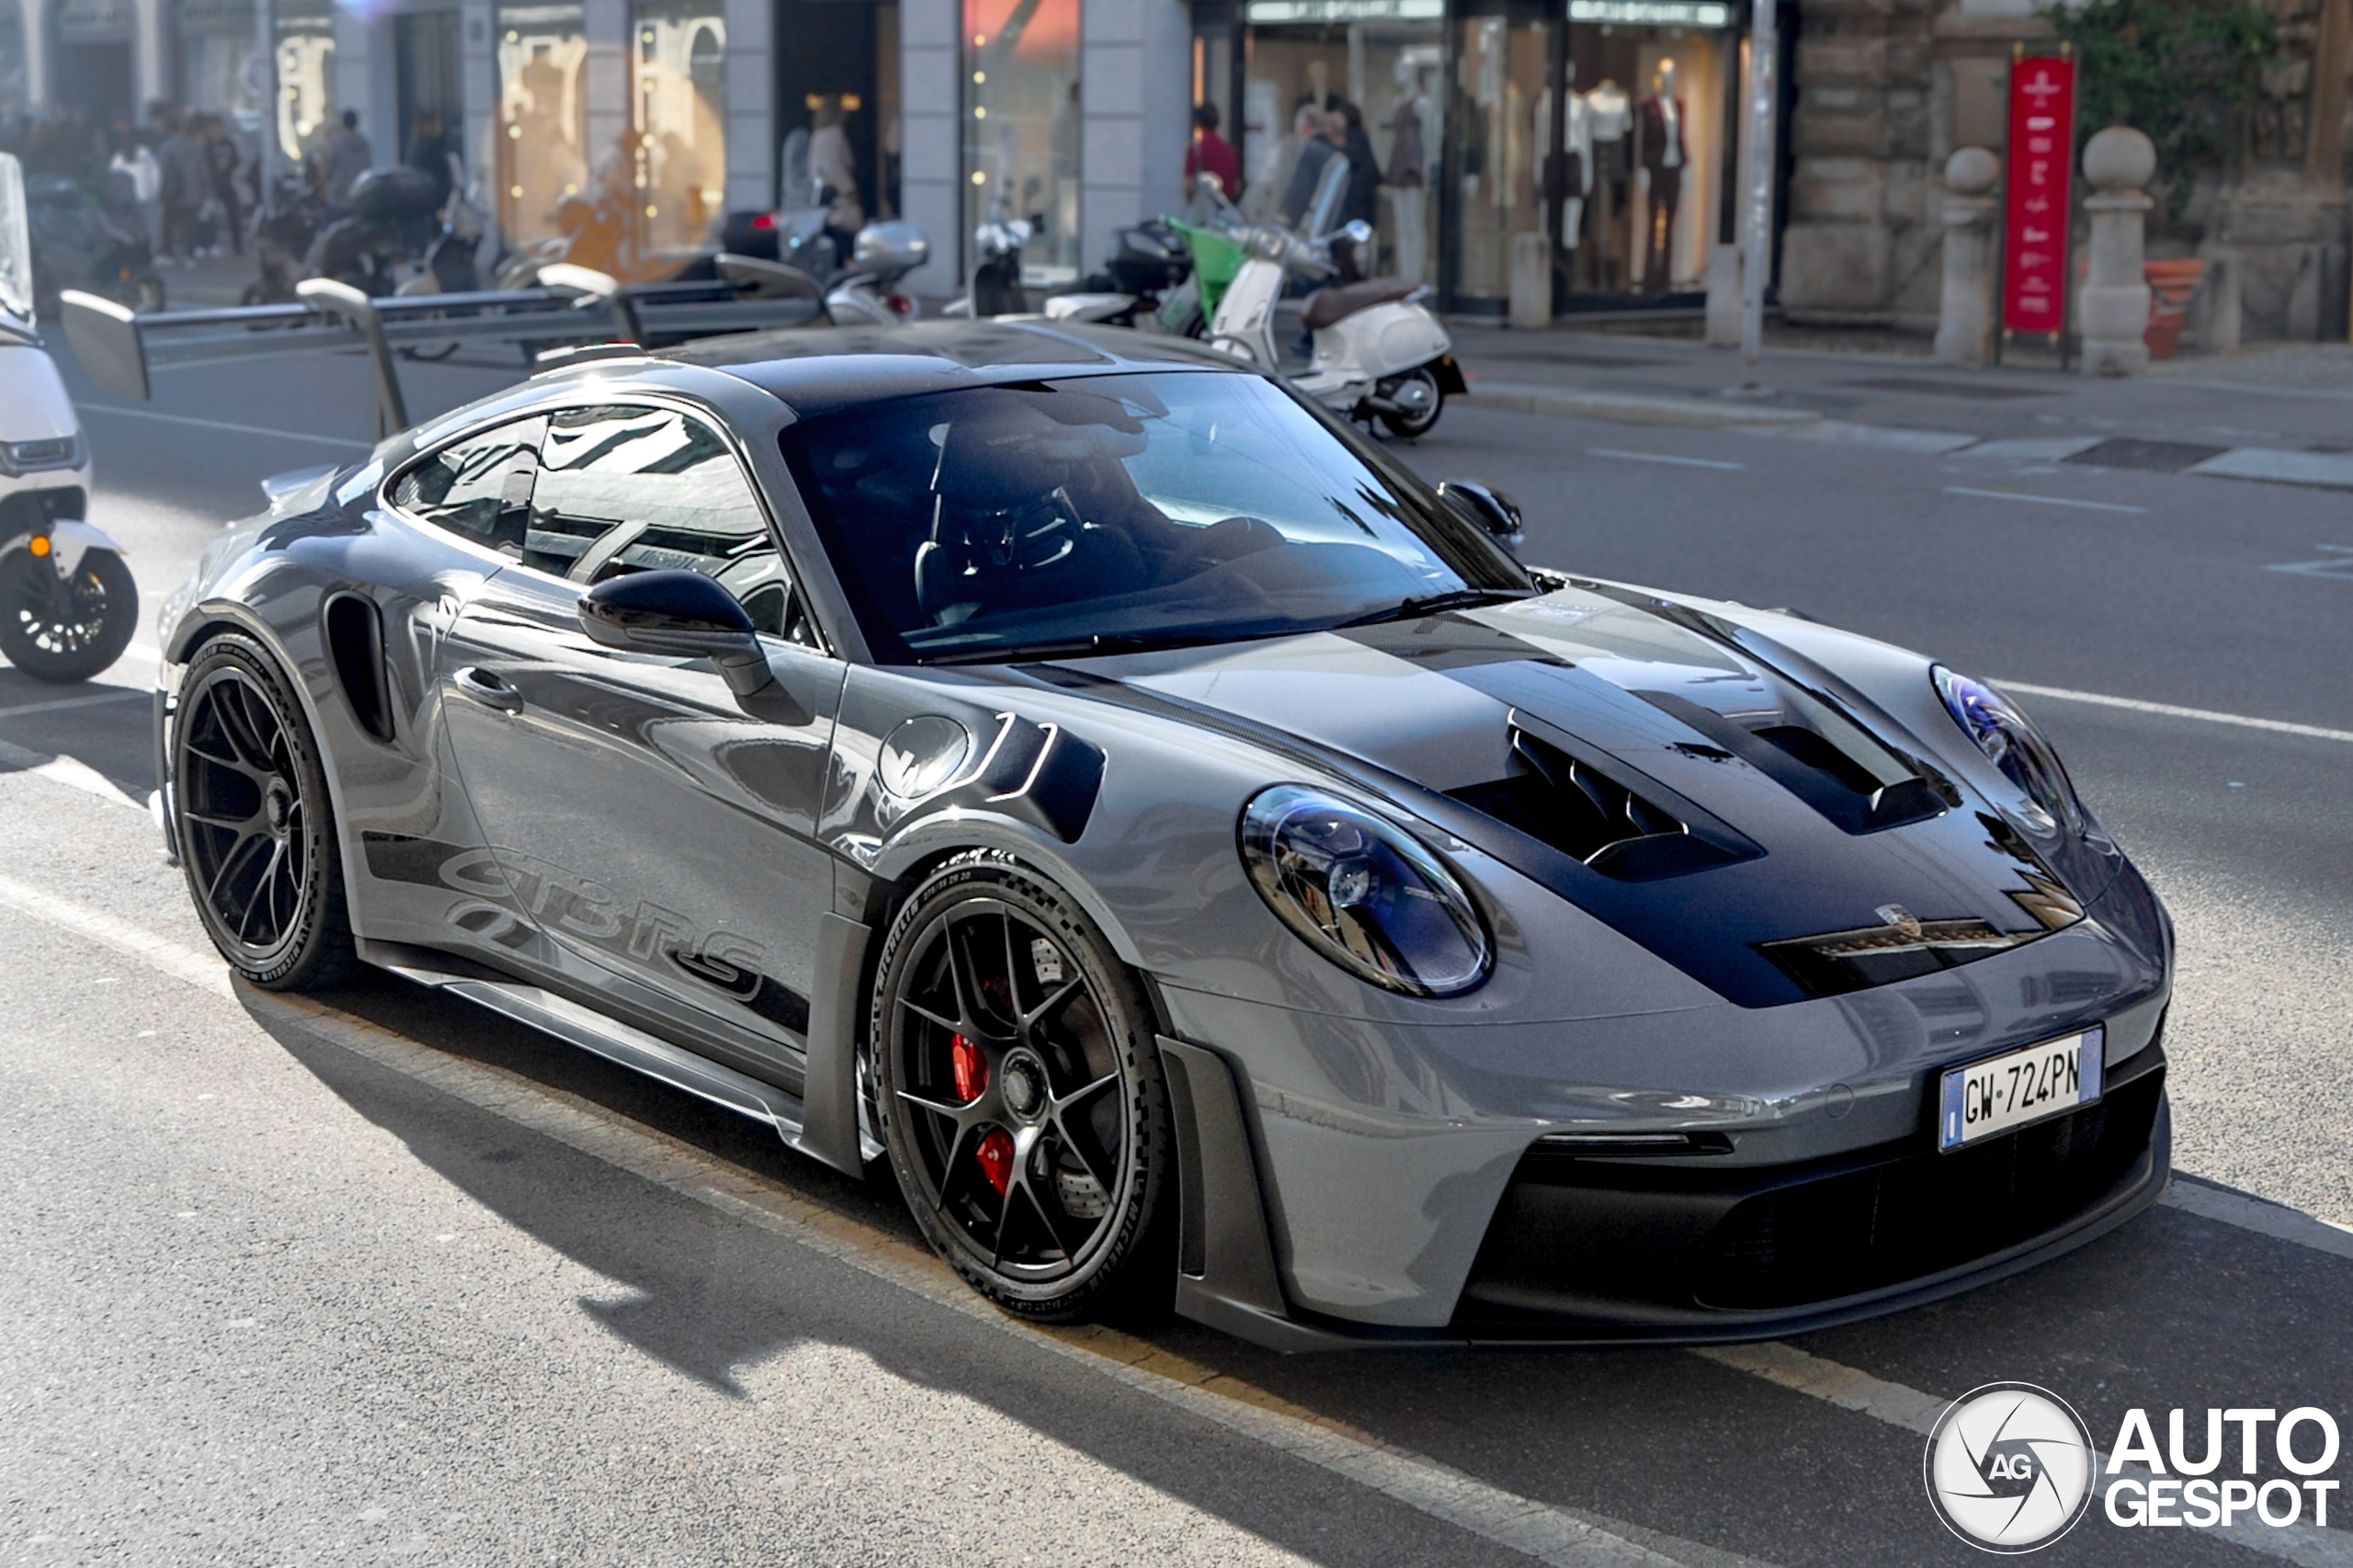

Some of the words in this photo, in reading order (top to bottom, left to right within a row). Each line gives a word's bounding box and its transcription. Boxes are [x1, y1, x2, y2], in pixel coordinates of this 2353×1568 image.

[261, 943, 301, 982] MICHELIN
[628, 897, 767, 1002] RS
[876, 899, 919, 993] MICHELIN
[1088, 1200, 1139, 1291] MICHELIN
